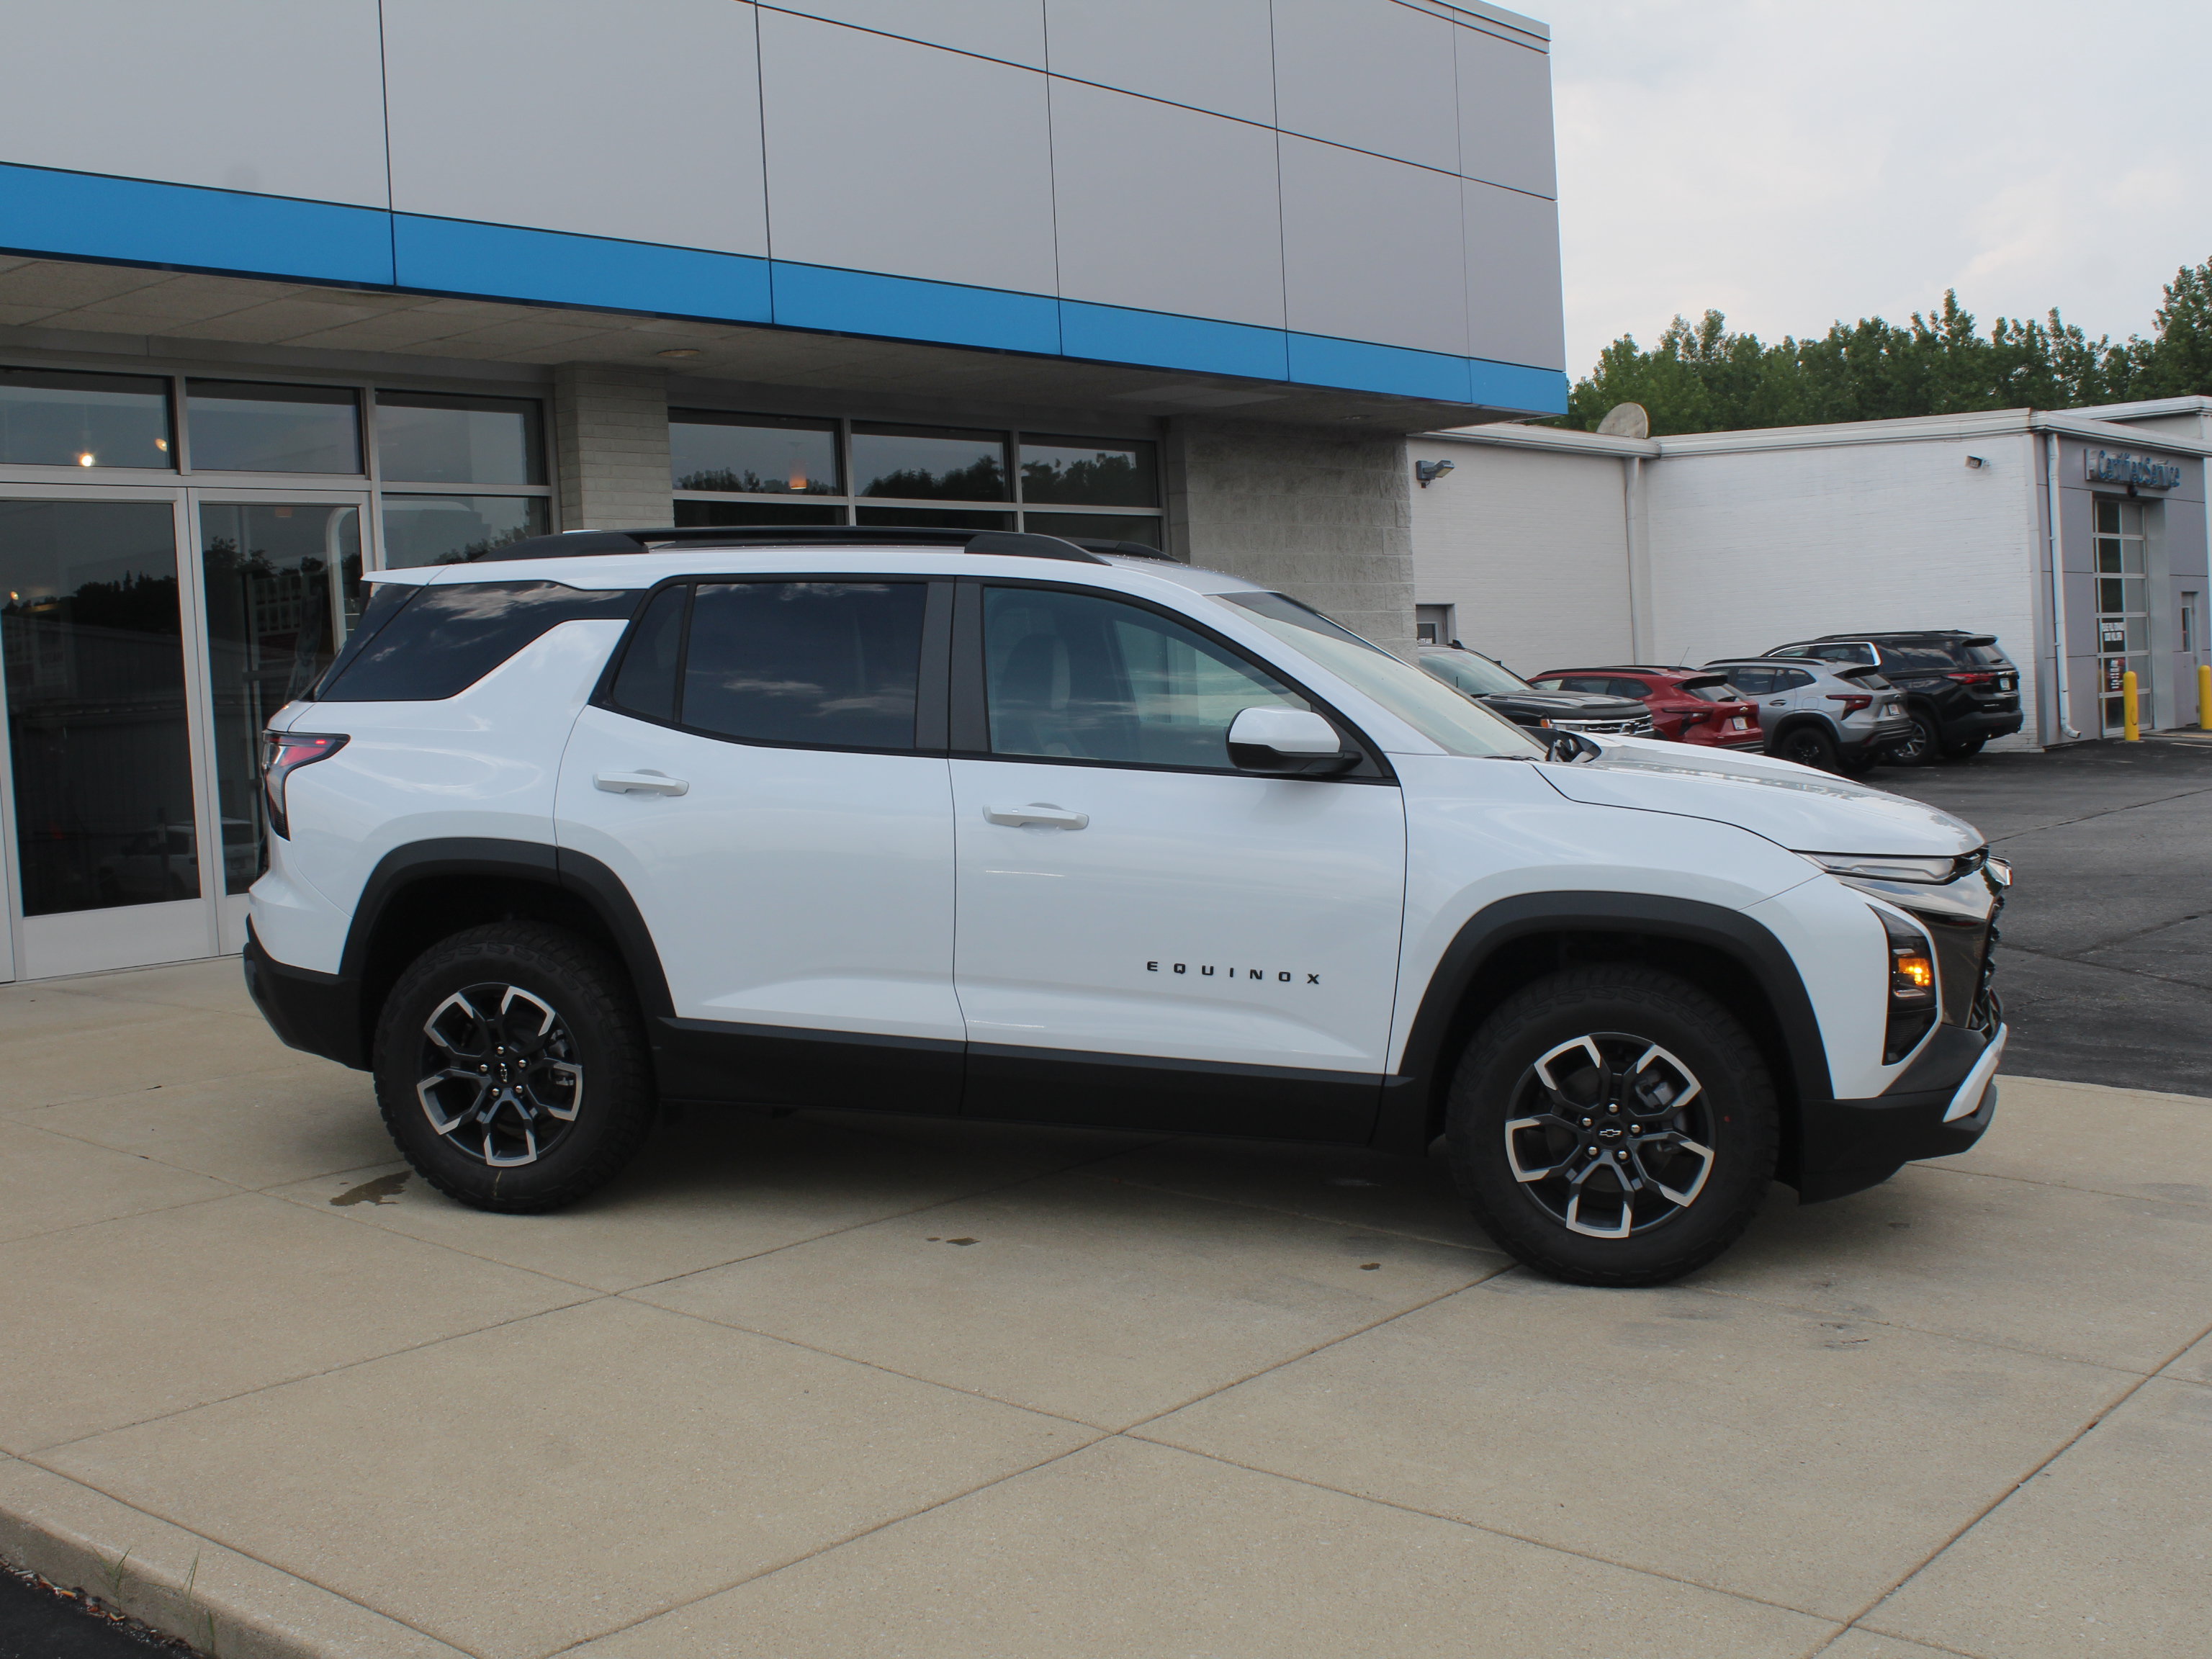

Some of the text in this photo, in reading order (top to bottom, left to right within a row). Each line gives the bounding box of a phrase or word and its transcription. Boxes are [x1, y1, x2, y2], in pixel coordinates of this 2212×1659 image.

[2098, 449, 2180, 487] Certified Service
[1146, 961, 1320, 985] EQUINOX
